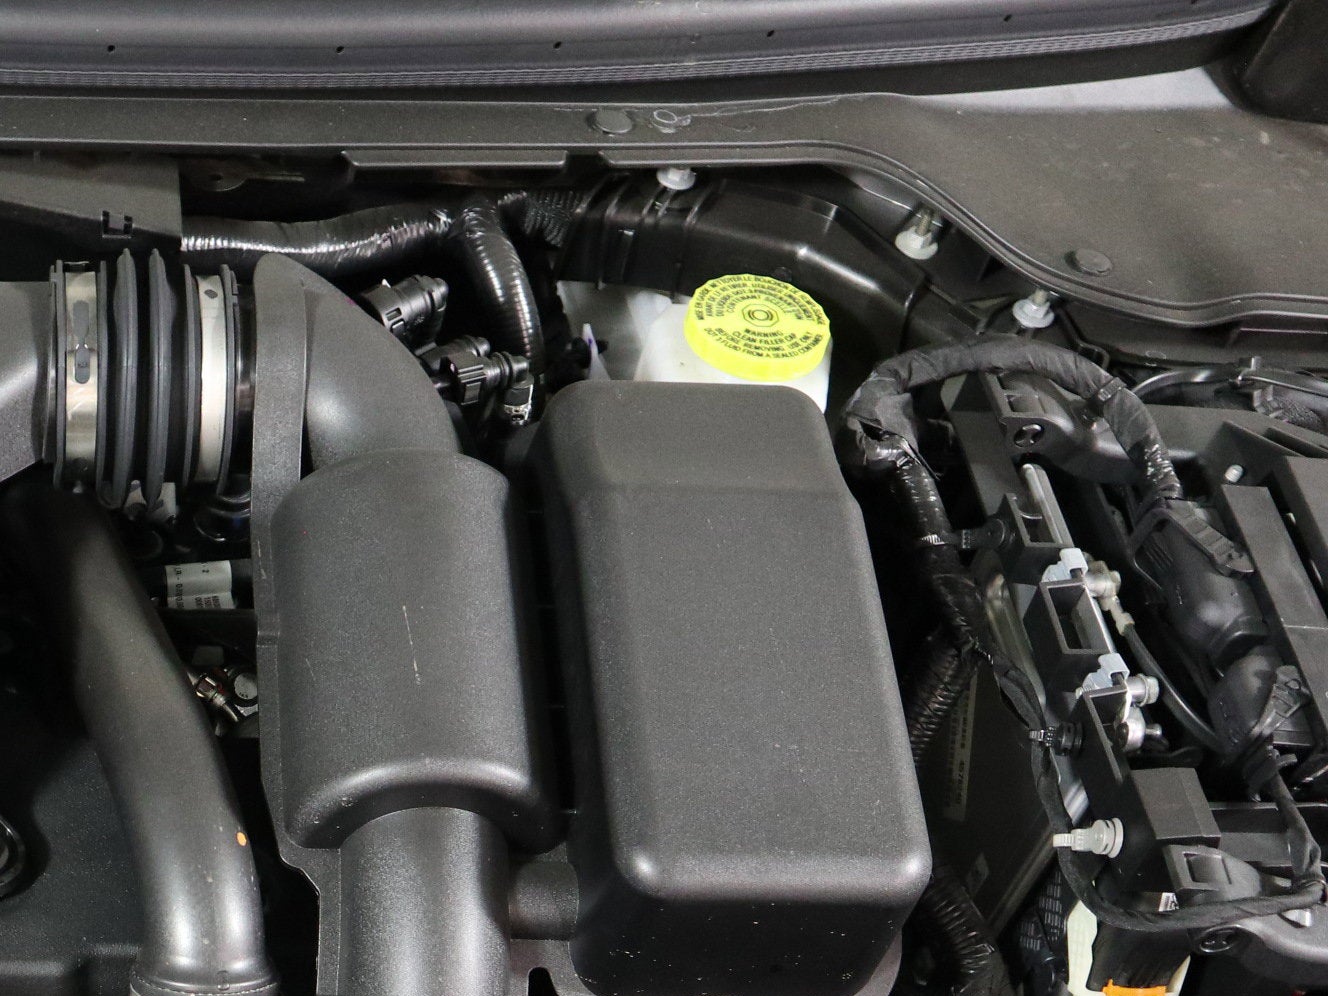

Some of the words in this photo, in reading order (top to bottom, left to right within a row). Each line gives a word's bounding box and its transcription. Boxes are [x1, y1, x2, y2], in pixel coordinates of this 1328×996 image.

[715, 328, 739, 344] BEFORE
[733, 331, 756, 343] CLEAN
[759, 338, 785, 346] FILLER
[784, 333, 797, 342] CAP
[744, 328, 783, 338] WARNING
[721, 340, 741, 351] FLUID
[742, 349, 763, 357] FROM
[772, 350, 799, 358] SEALED
